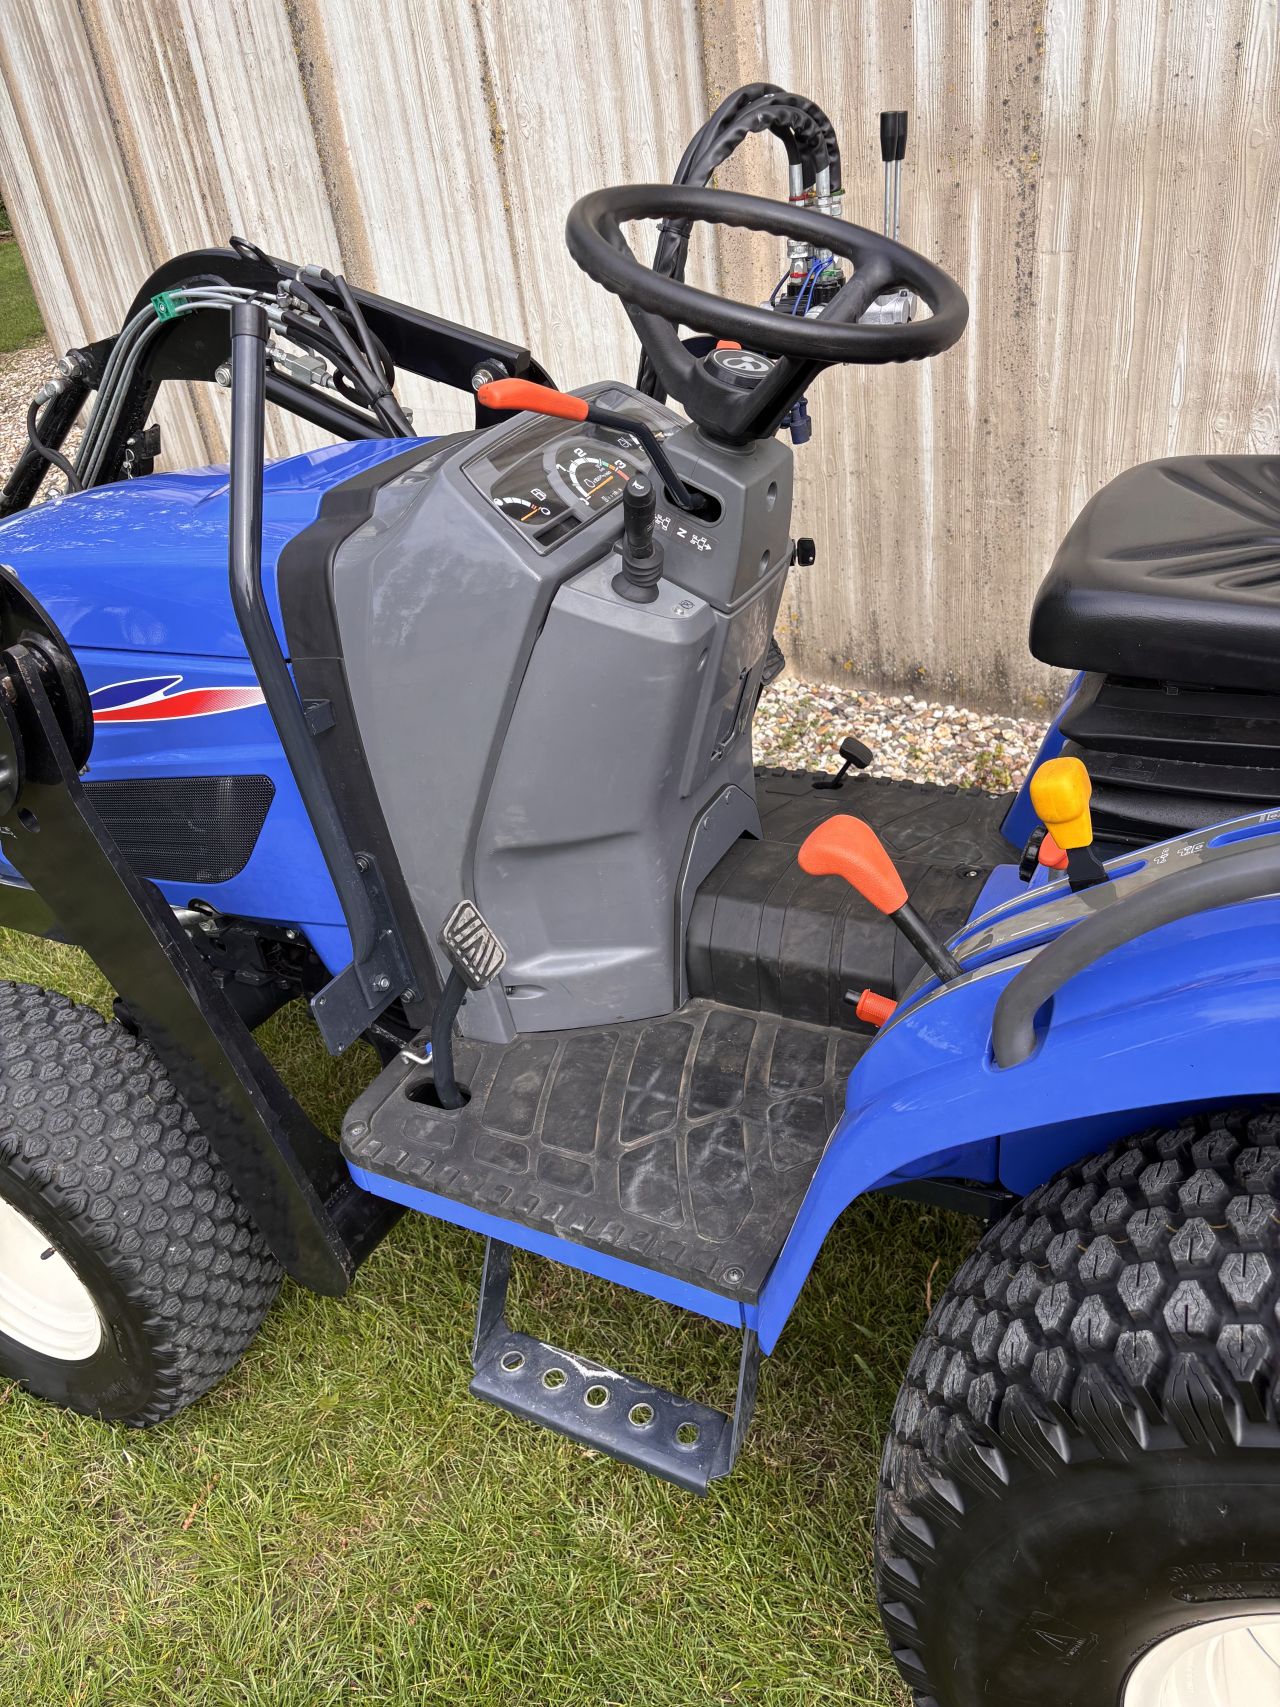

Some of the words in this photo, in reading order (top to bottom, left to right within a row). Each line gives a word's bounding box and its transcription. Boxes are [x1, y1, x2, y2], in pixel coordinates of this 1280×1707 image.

[574, 447, 587, 458] 2
[614, 459, 627, 470] 3
[676, 527, 688, 539] N
